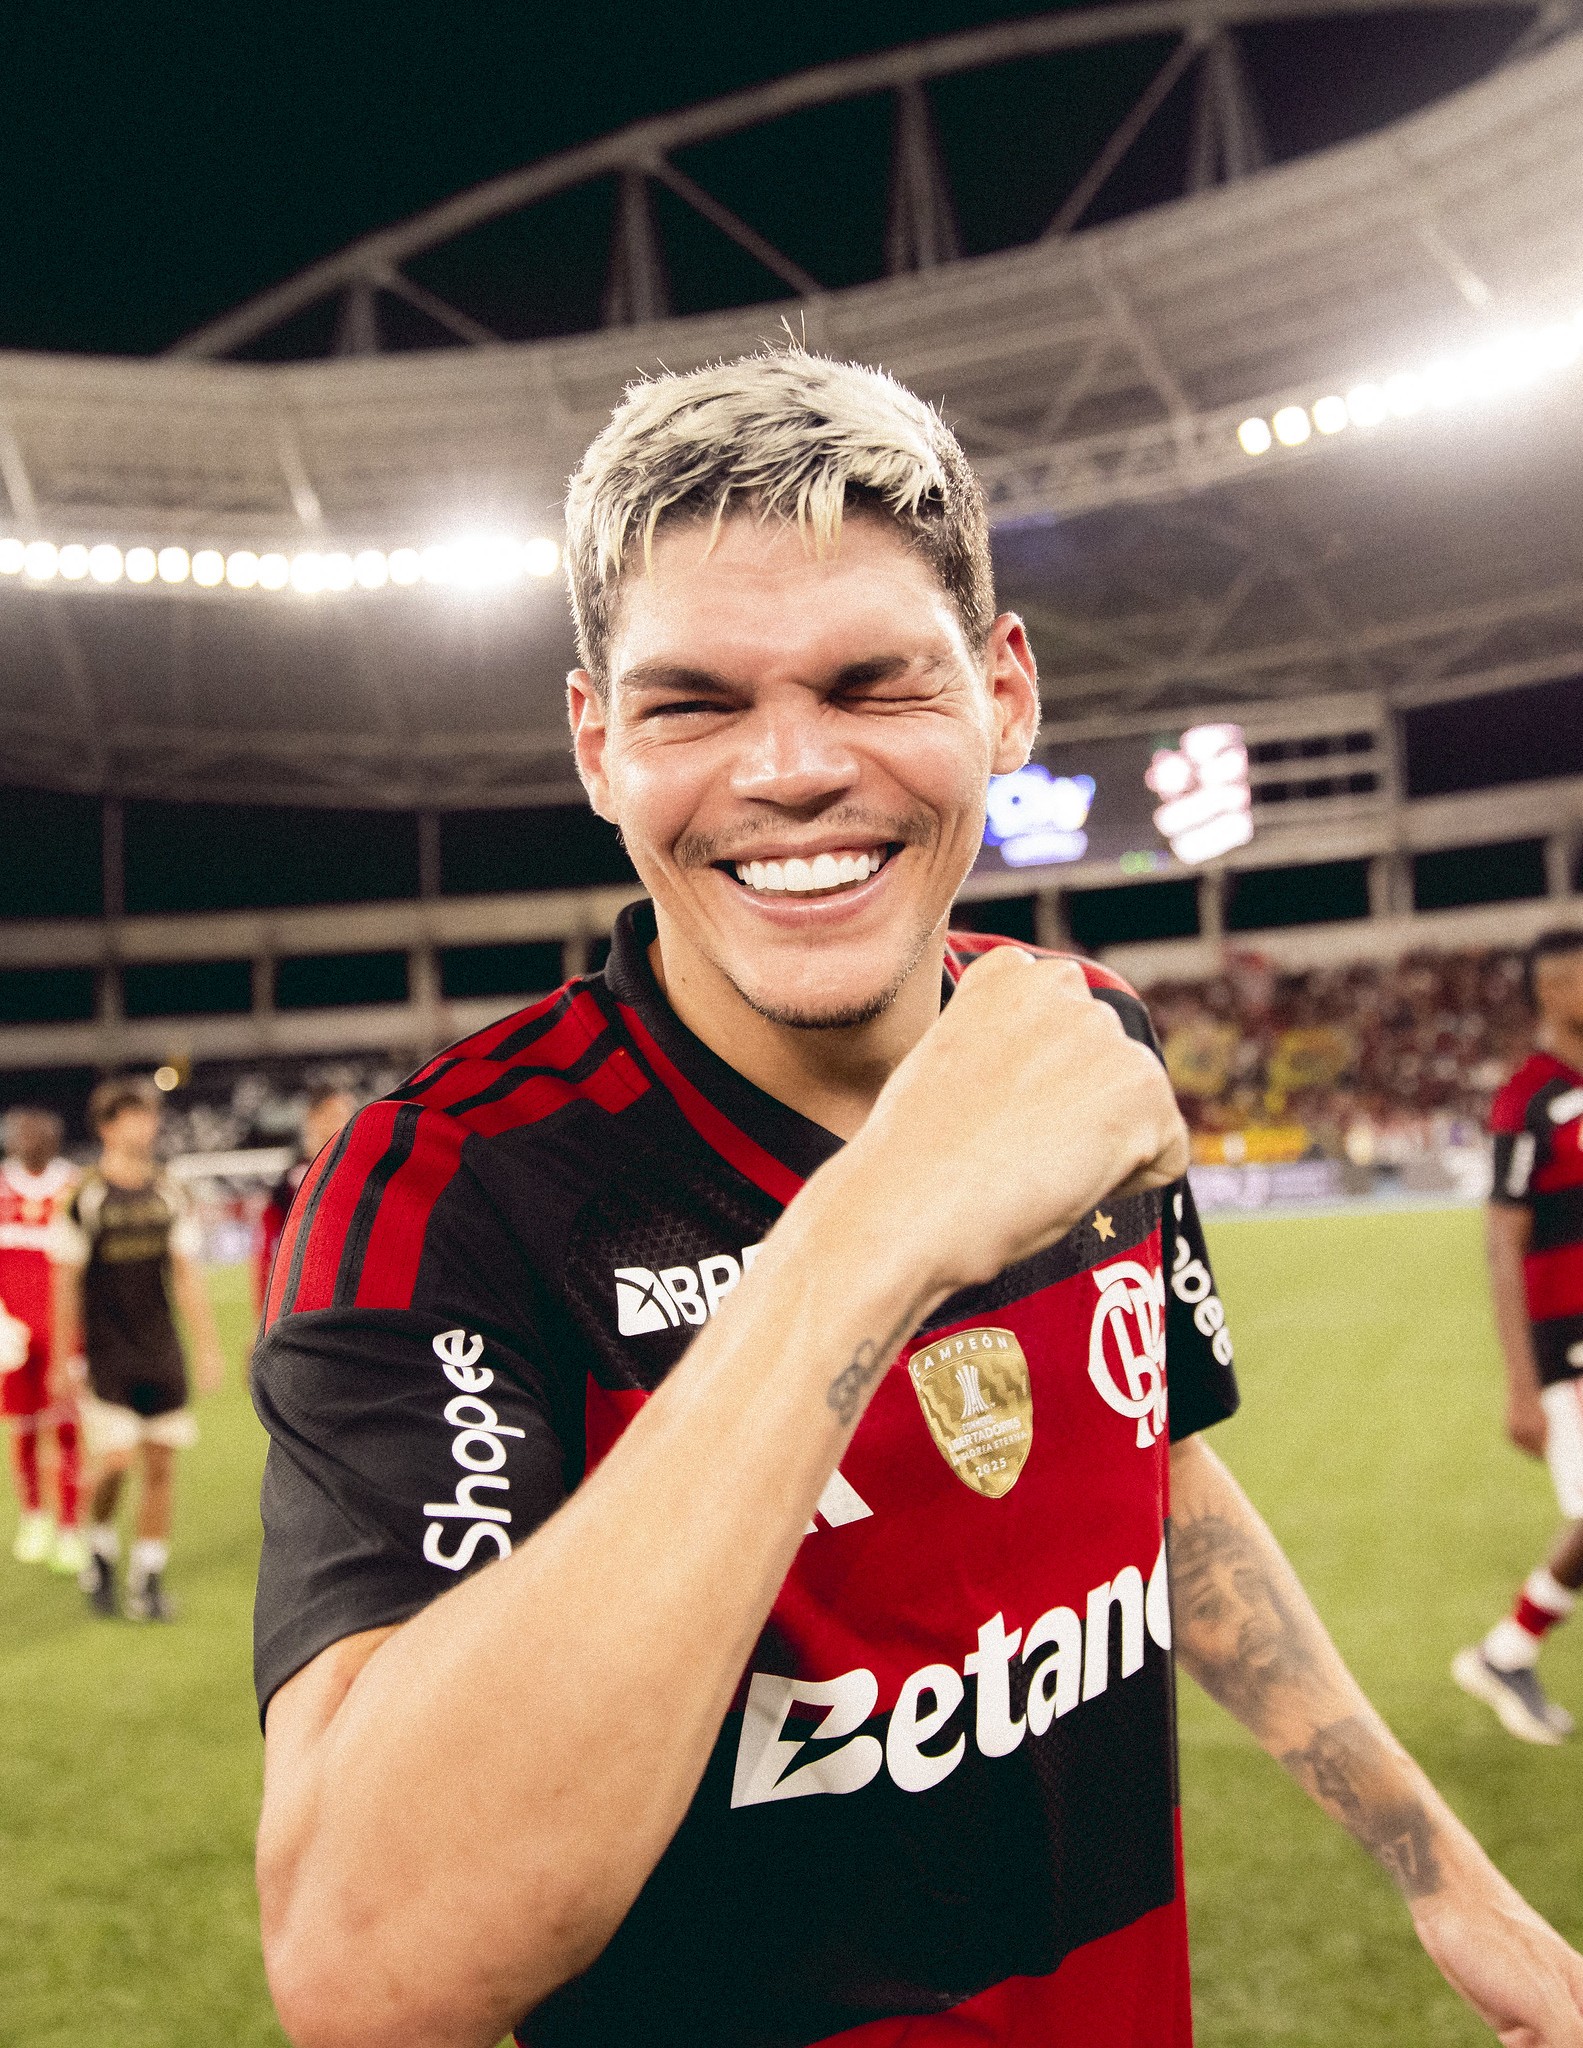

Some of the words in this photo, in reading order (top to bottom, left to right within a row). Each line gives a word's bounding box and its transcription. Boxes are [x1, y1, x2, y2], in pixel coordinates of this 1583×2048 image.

[912, 1333, 1008, 1378] CAMPEÓN
[423, 1329, 526, 1571] Shopee
[975, 1457, 1007, 1478] 2025
